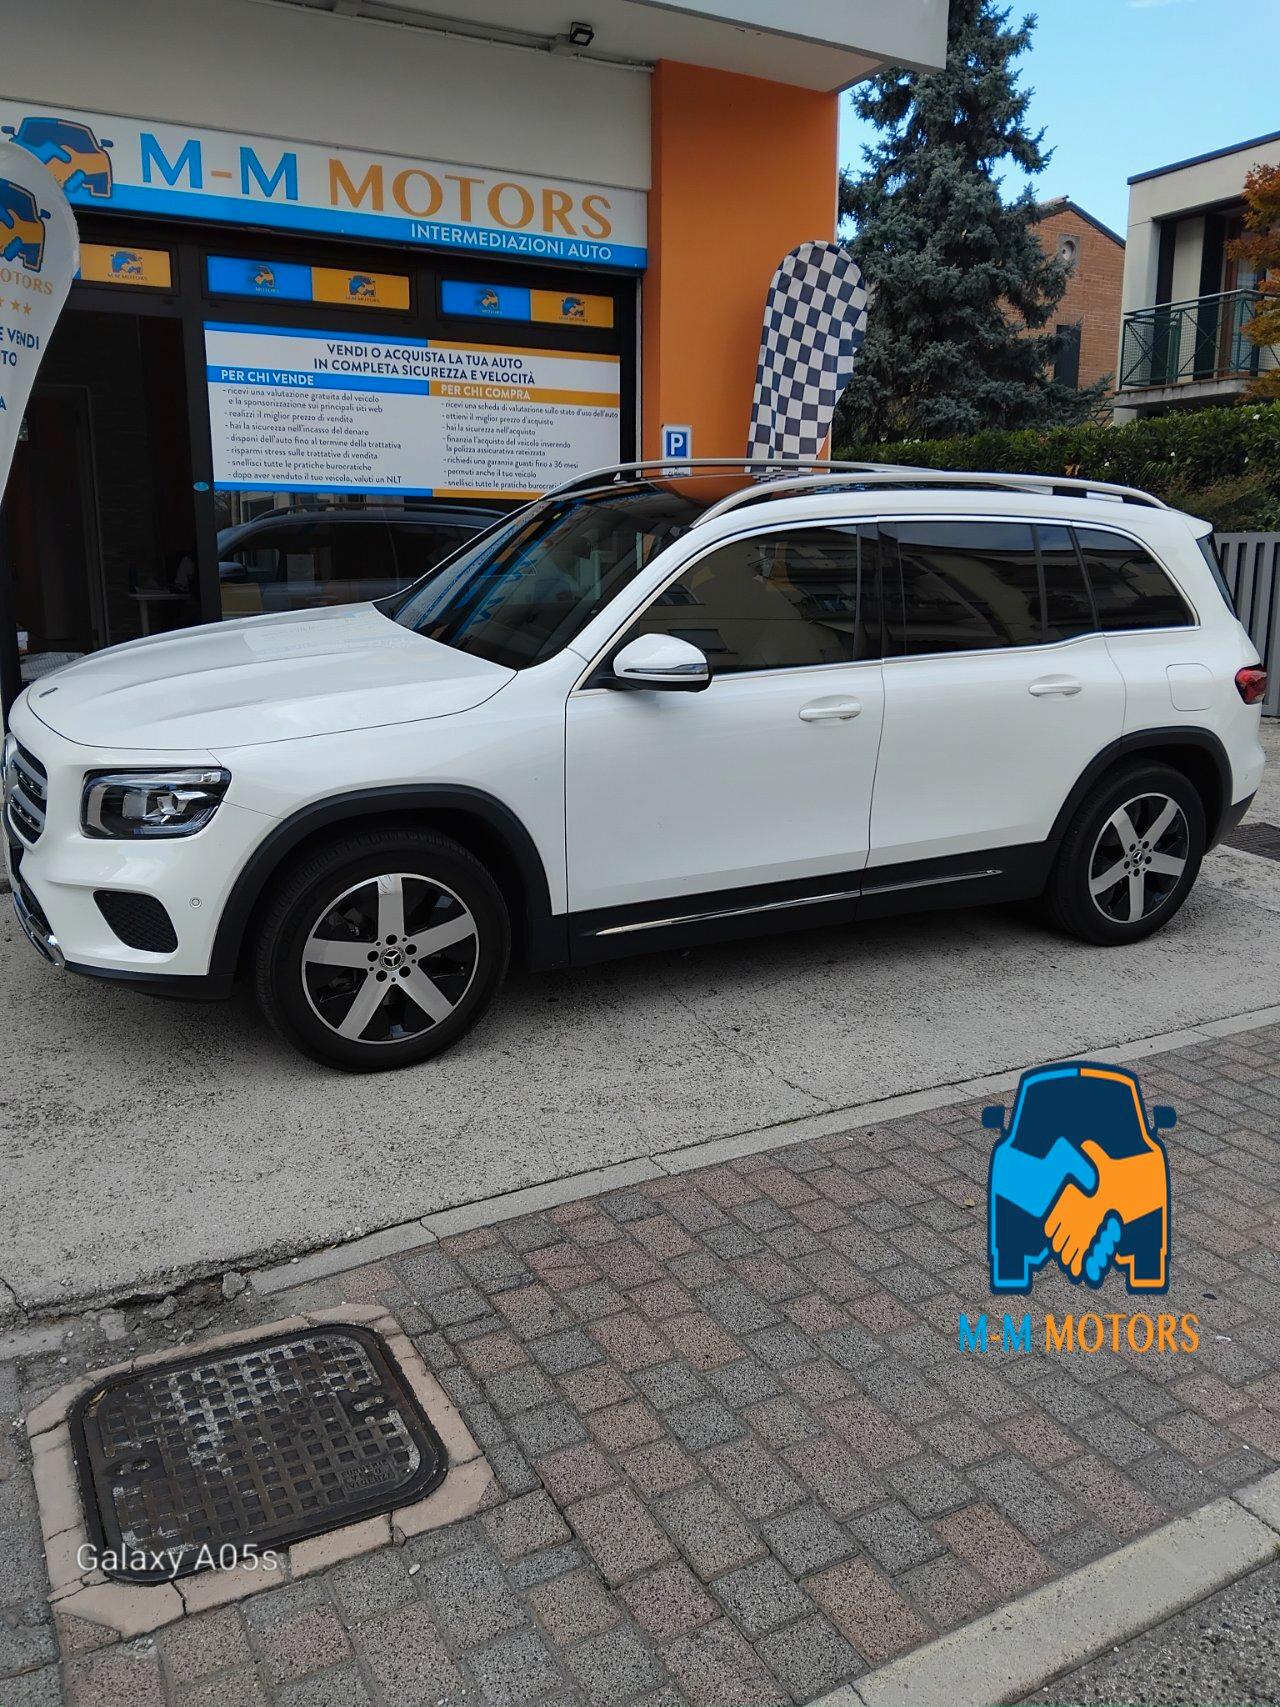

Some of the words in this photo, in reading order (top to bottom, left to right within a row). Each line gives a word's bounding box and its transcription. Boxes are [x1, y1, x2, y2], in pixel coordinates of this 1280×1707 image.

[139, 132, 298, 201] M-M
[329, 158, 612, 239] MOTORS
[411, 223, 564, 255] INTERMEDIAZIONI
[568, 243, 612, 260] AUTO
[0, 268, 53, 295] OTORS
[7, 328, 39, 350] VENDI
[0, 350, 17, 367] TO
[327, 344, 367, 358] VENDI
[371, 347, 381, 358] O
[384, 349, 445, 364] ACQUISTA
[449, 353, 463, 365] LA
[466, 354, 488, 367] TUA
[491, 357, 523, 369] AUTO
[221, 369, 244, 381] PER
[247, 371, 269, 383] CHI
[272, 373, 314, 386] VENDE
[314, 358, 328, 369] IN
[332, 360, 399, 375] COMPLETA
[402, 364, 468, 380] SICUREZZA
[471, 370, 477, 380] E
[480, 371, 535, 385] VELOCITÀ
[267, 388, 309, 399] valutazione
[311, 393, 340, 401] gratuita
[354, 394, 380, 403] veicolo
[441, 384, 461, 395] PER
[463, 385, 483, 397] CHI
[485, 387, 531, 400] COMPRA
[235, 397, 242, 405] la
[244, 400, 306, 408] sponsorizzazione
[320, 402, 354, 412] principali
[356, 404, 367, 412] siti
[446, 400, 463, 408] ricevi
[478, 402, 499, 411] scheda
[508, 405, 543, 413] valutazione
[229, 409, 255, 418] realizzi
[263, 412, 290, 422] miglior
[292, 414, 316, 422] prezzo
[326, 415, 354, 423] vendita
[446, 412, 468, 420] ottieni
[476, 414, 498, 424] miglior
[500, 417, 521, 425] prezzo
[522, 416, 554, 426] d'acquisto
[229, 421, 242, 429] hai
[243, 422, 250, 430] la
[252, 422, 286, 432] sicurezza
[331, 426, 343, 434] del
[344, 427, 369, 436] denaro
[446, 423, 457, 431] hai
[465, 425, 495, 433] sicurezza
[230, 433, 258, 444] disponi
[294, 436, 309, 445] fino
[311, 437, 318, 445] al
[320, 439, 348, 447] termine
[350, 439, 367, 447] della
[368, 441, 401, 449] trattativa
[447, 434, 473, 443] finanzia
[517, 439, 539, 447] veicolo
[540, 441, 571, 449] inserendo
[670, 433, 683, 455] P
[231, 447, 263, 456] risparmi
[307, 450, 341, 458] trattative
[352, 451, 378, 460] vendita
[446, 444, 452, 452] la
[453, 445, 476, 454] polizza
[232, 458, 262, 467] snellisci
[264, 460, 283, 468] tutte
[285, 460, 292, 468] le
[293, 461, 325, 470] pratiche
[326, 462, 372, 471] burocratiche
[447, 456, 472, 464] richiedi
[487, 459, 514, 468] garanzia
[515, 461, 533, 469] guasti
[535, 460, 548, 468] fino
[554, 460, 563, 468] 36
[233, 471, 252, 480] dopo
[272, 472, 303, 480] venduto
[354, 475, 374, 483] valuti
[386, 475, 402, 484] NLT
[448, 468, 474, 477] permuti
[476, 469, 495, 477] anche
[497, 469, 501, 477] il
[493, 480, 499, 488] le
[500, 481, 527, 490] pratiche
[528, 481, 562, 490] burocrati
